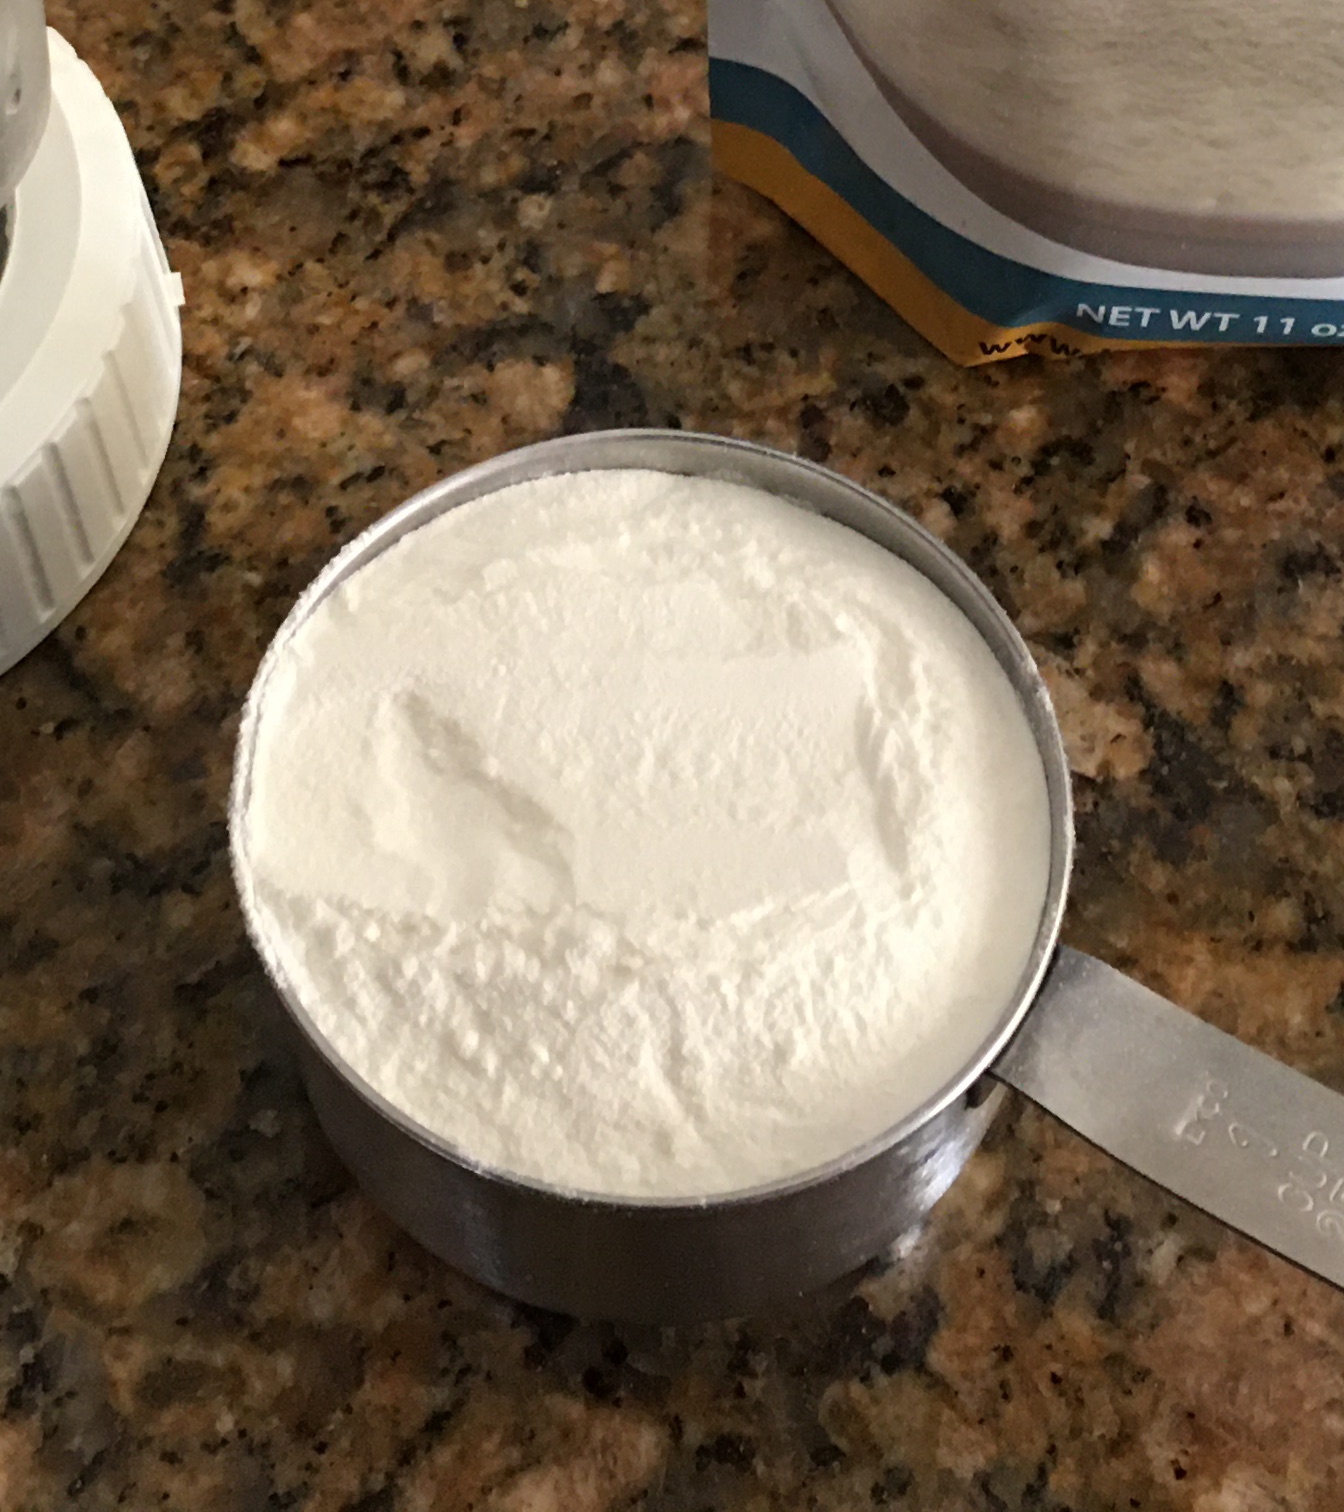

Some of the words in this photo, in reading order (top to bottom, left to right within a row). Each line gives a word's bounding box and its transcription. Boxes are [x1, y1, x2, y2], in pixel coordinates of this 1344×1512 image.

[1076, 303, 1160, 329] NET
[1169, 309, 1241, 333] WT
[1253, 315, 1295, 336] 11
